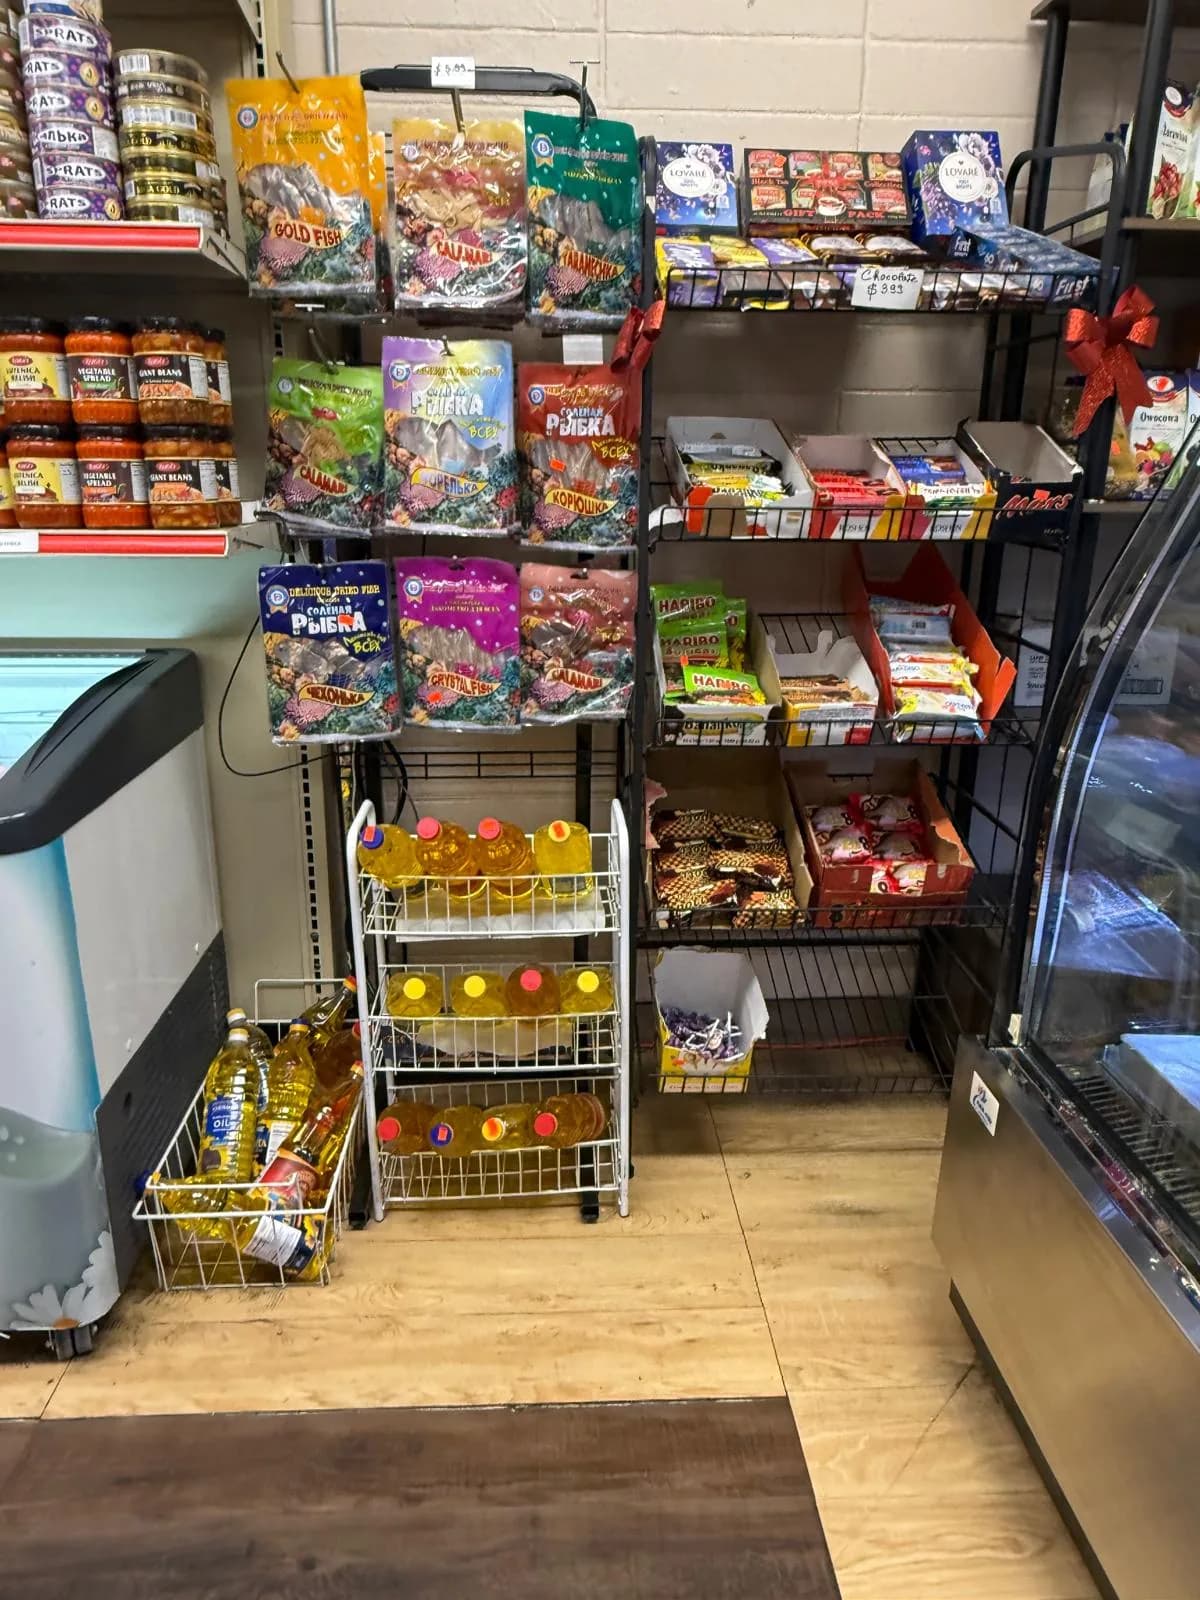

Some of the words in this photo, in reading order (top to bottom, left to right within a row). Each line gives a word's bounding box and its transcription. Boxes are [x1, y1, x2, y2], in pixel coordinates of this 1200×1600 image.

[35, 27, 95, 44] SPRATS
[46, 164, 103, 177] SPRATS
[783, 208, 816, 218] GIFT
[847, 210, 885, 219] PACK
[275, 223, 311, 243] GOLD
[313, 228, 342, 247] FISH
[1055, 275, 1090, 296] First
[546, 413, 616, 437] РЫБКА
[1140, 411, 1179, 423] Owocowa
[552, 492, 609, 514] КОРЮШКА
[995, 492, 1074, 520] Mars
[658, 595, 717, 613] HARIBO
[660, 634, 720, 648] HARIBO
[693, 674, 753, 693] HARIBO
[213, 1118, 231, 1129] OIL
